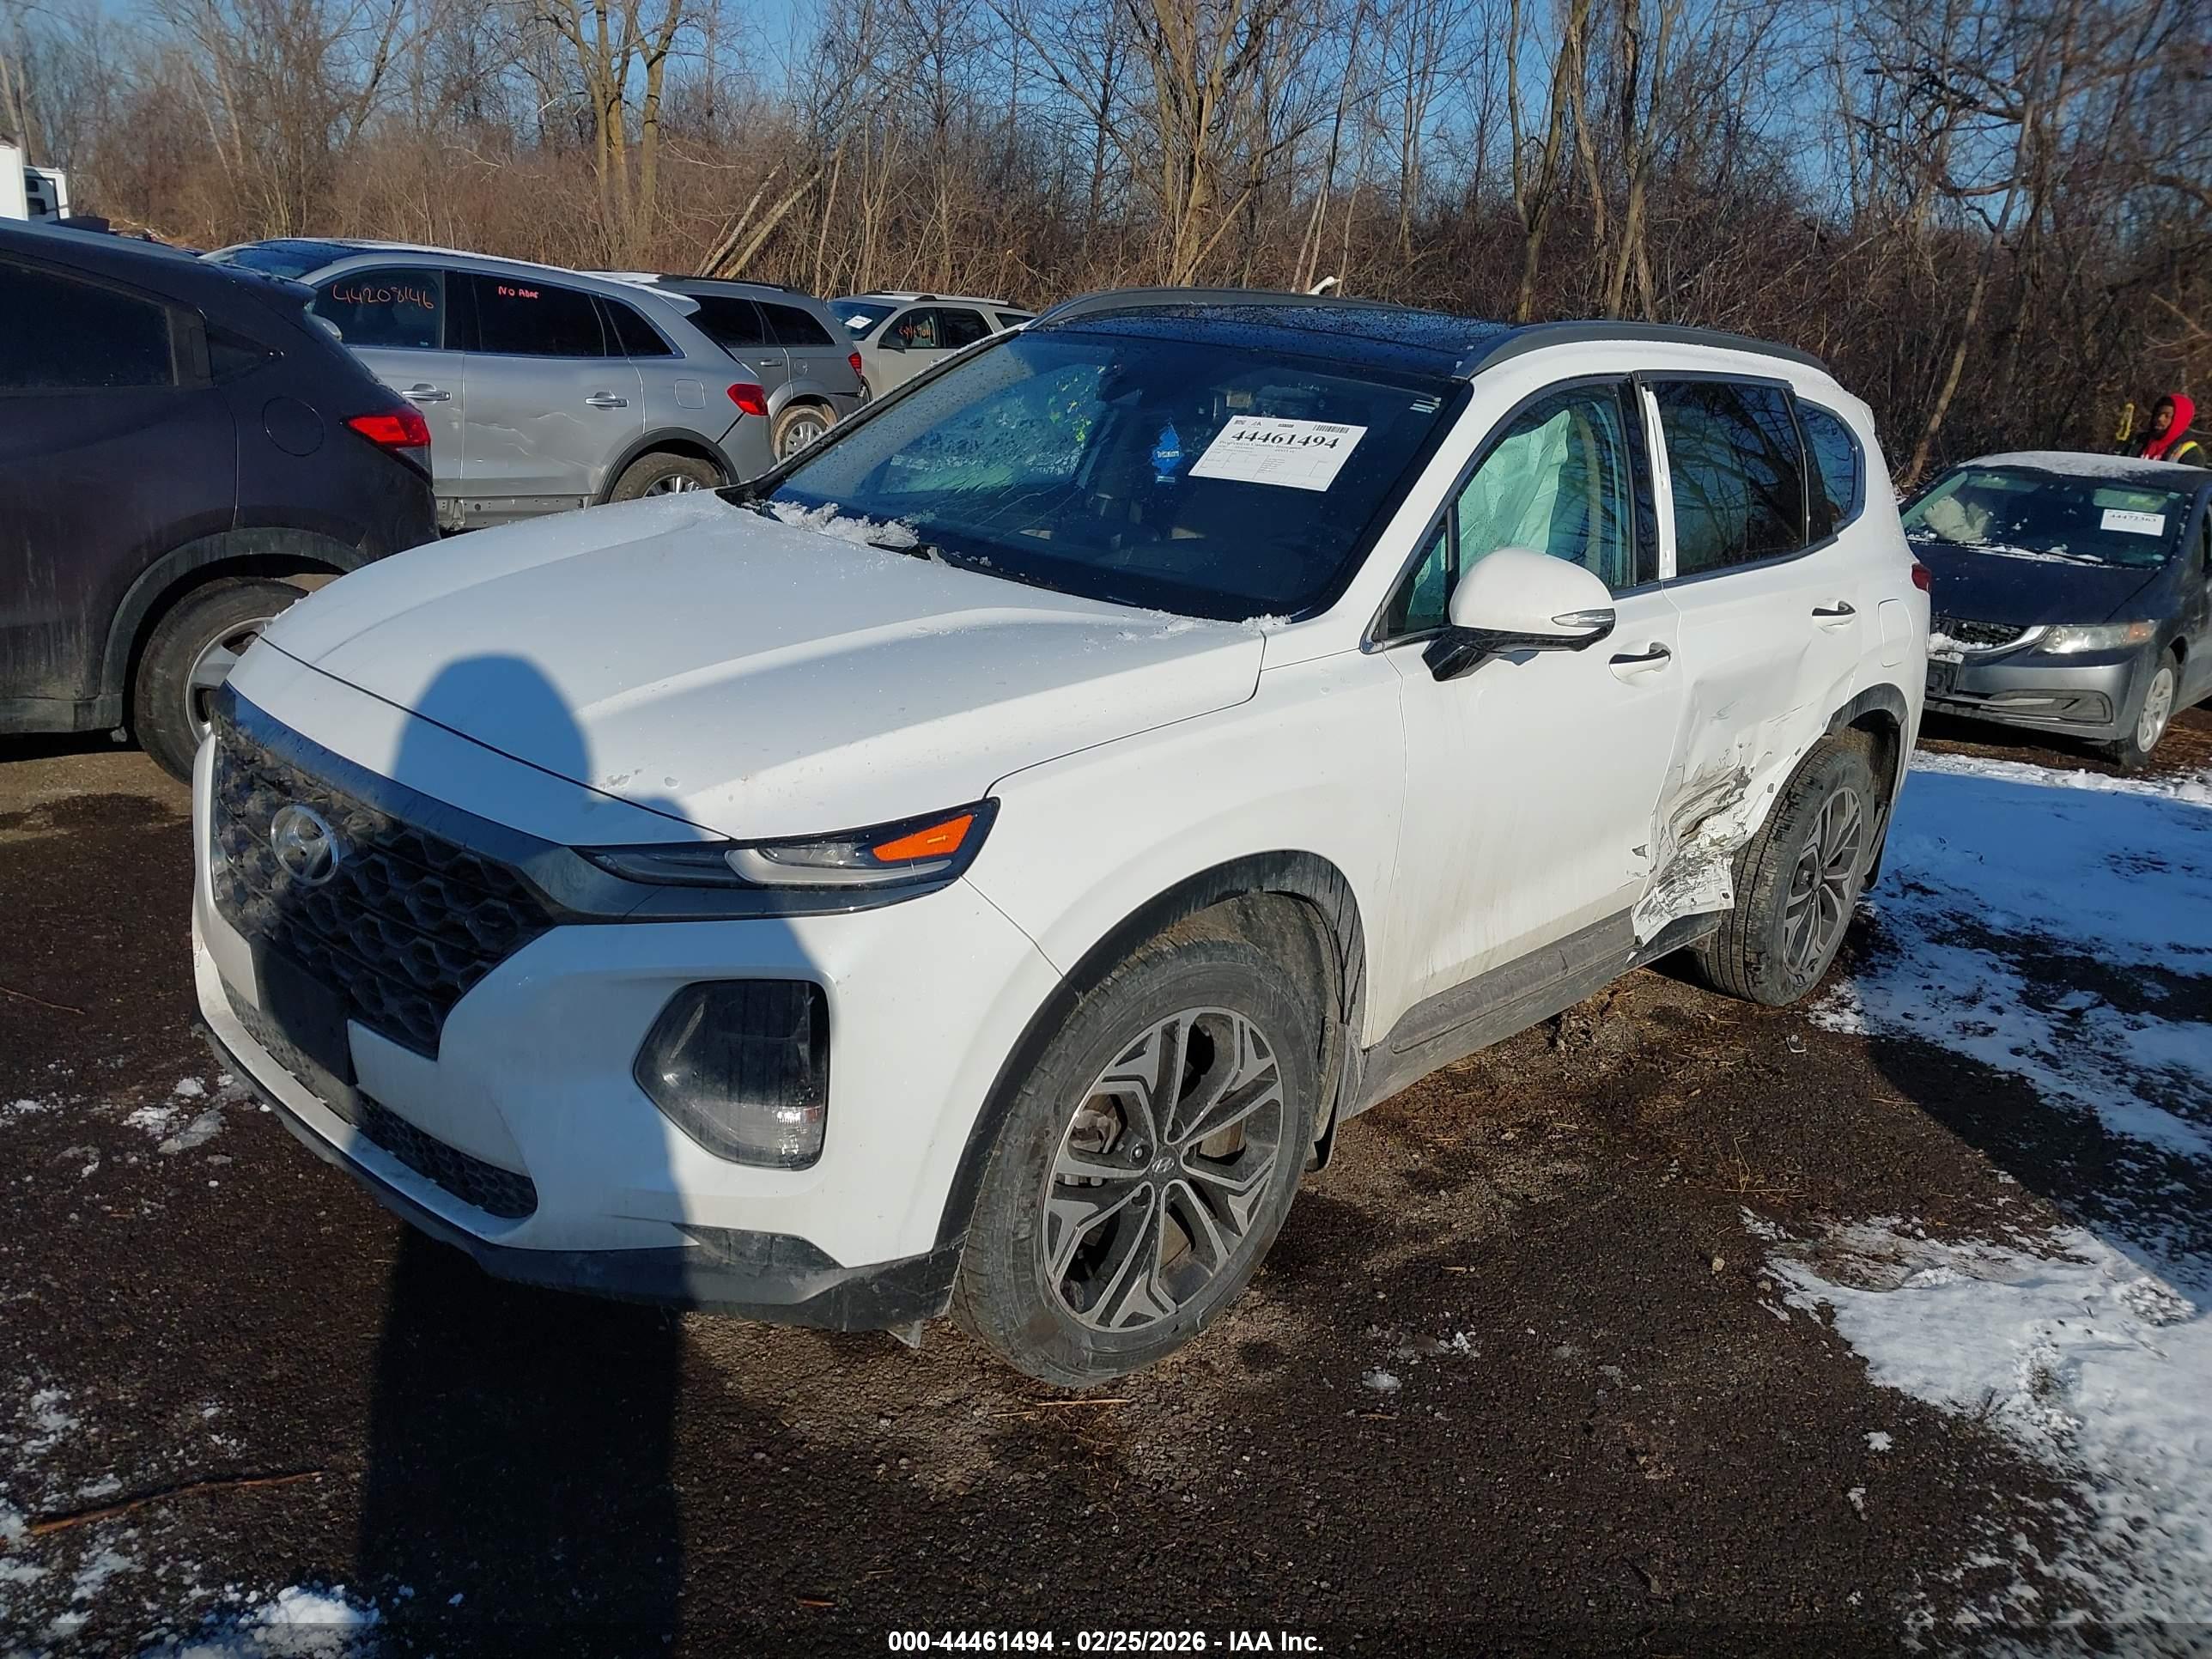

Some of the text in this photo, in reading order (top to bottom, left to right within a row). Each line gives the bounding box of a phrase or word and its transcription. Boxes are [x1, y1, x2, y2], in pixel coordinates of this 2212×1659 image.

[333, 284, 434, 308] 44208146
[498, 285, 515, 296] NO
[1231, 430, 1340, 449] 44461494
